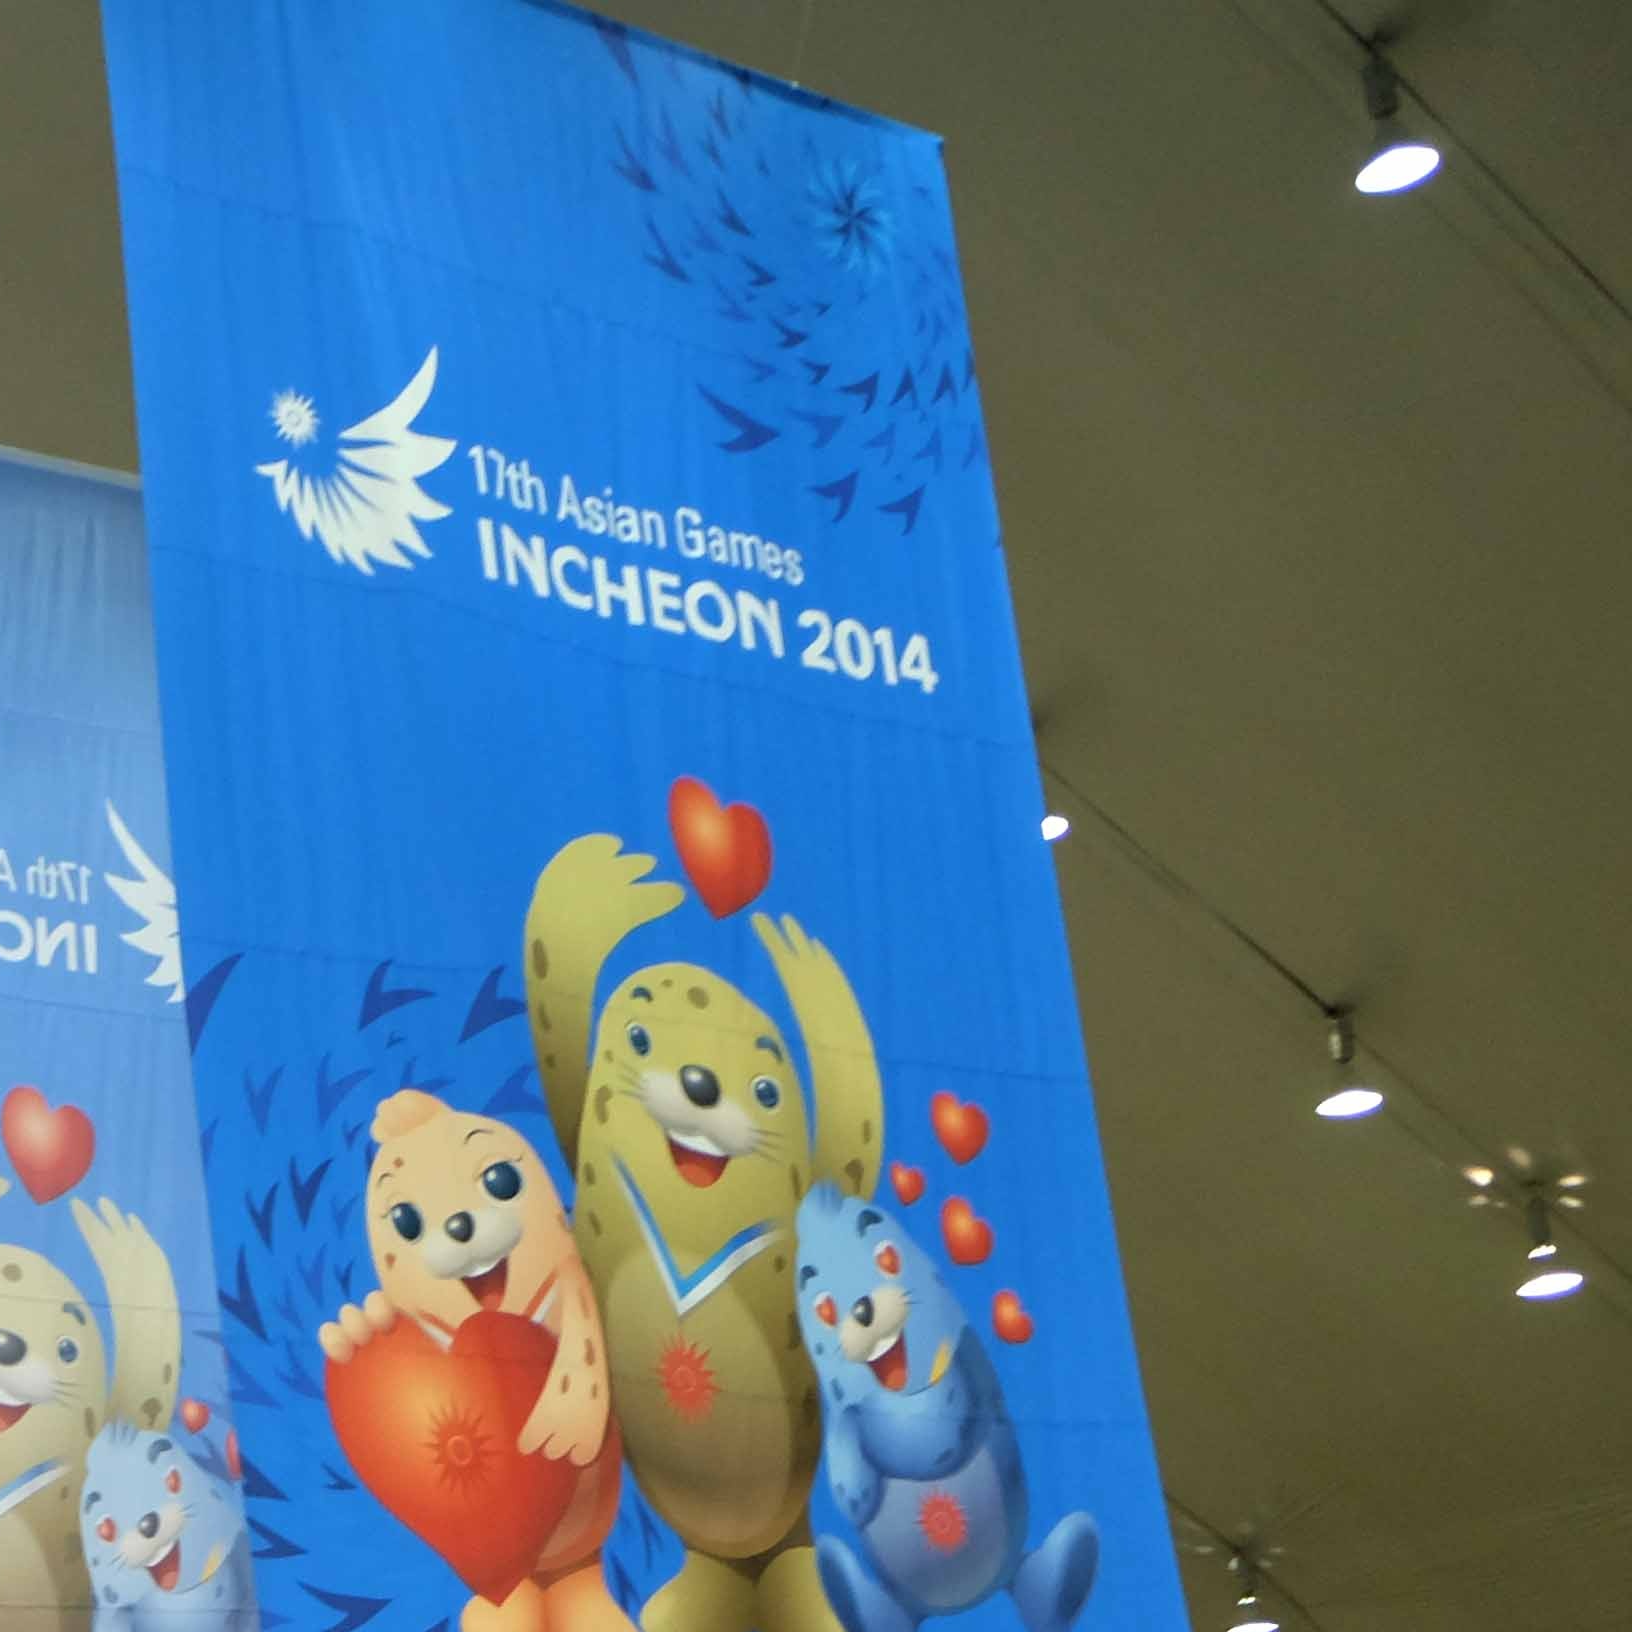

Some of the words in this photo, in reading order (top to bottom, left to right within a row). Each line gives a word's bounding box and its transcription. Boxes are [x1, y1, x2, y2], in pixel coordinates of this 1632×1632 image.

[468, 445, 548, 514] 17th
[557, 475, 666, 549] Asian
[676, 504, 805, 586] Games
[477, 518, 785, 659] INCHEON
[797, 609, 938, 693] 2014
